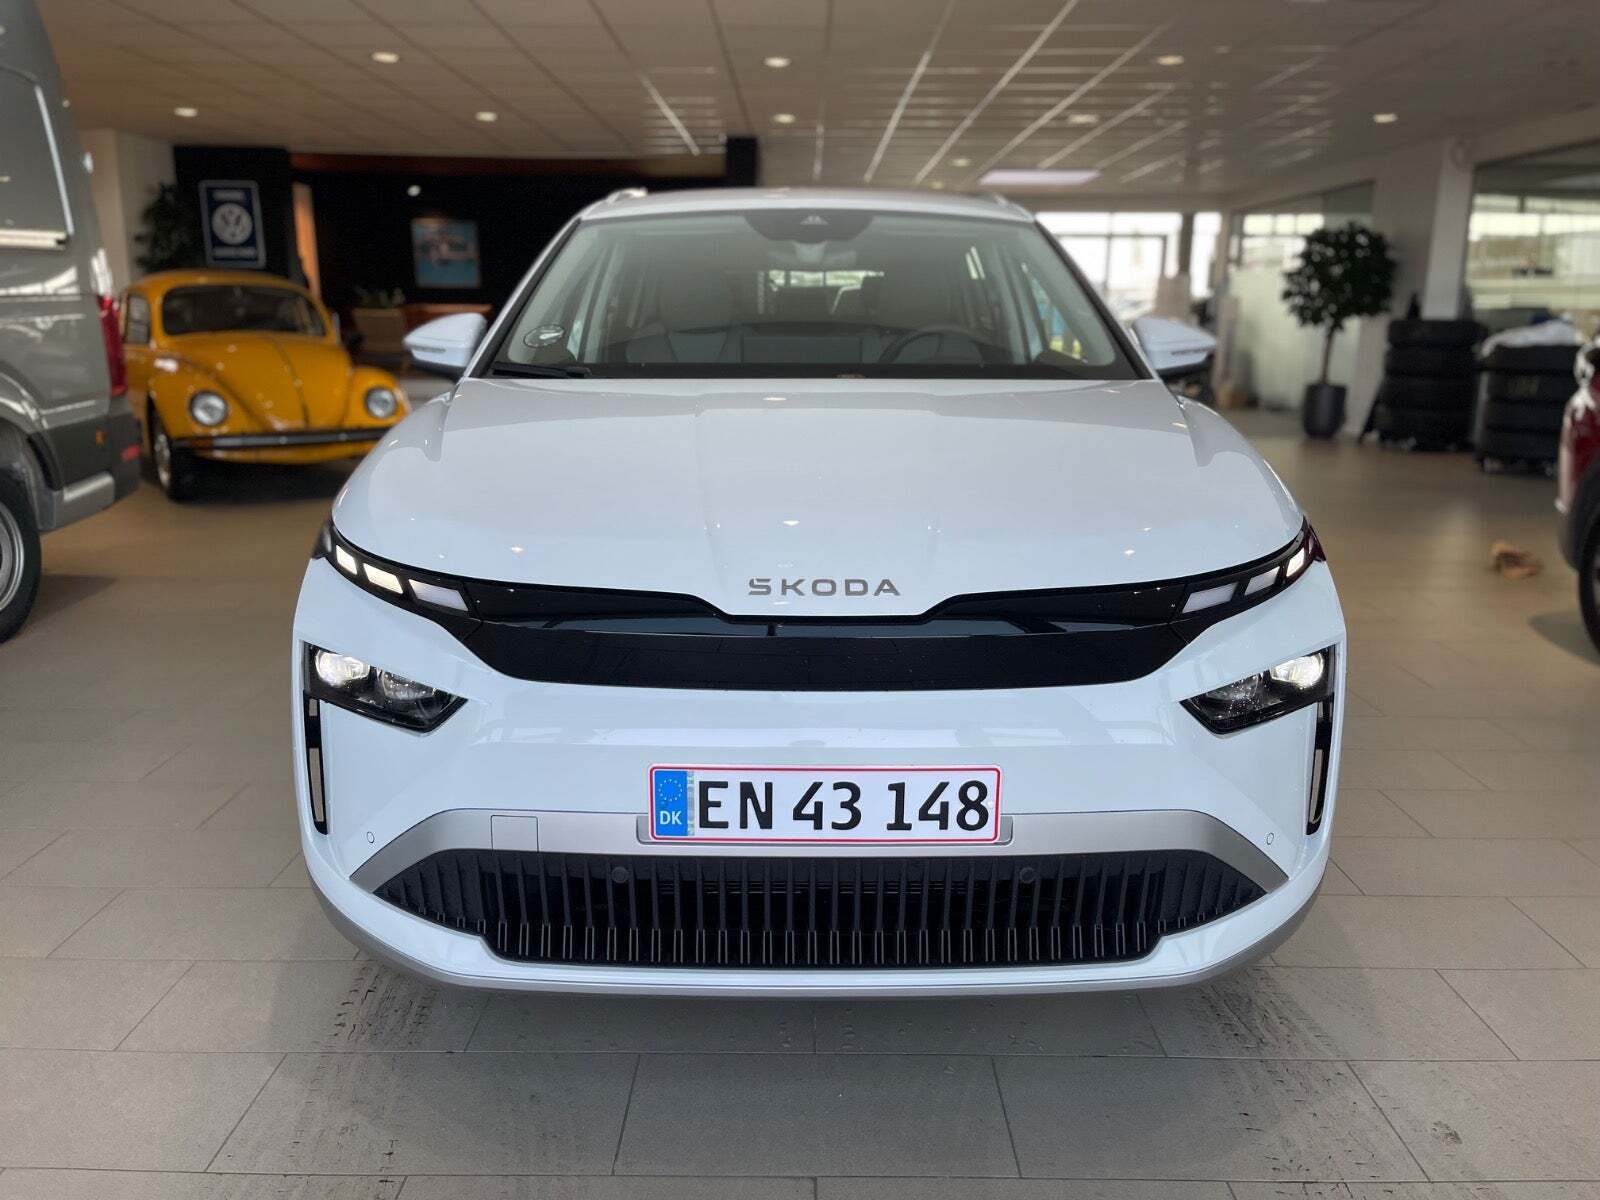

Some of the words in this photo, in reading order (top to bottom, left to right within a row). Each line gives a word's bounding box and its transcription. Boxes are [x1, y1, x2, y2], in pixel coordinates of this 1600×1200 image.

[748, 578, 901, 597] SKODA
[698, 780, 774, 830] EN
[792, 781, 862, 831] 43
[886, 779, 989, 832] 148
[659, 810, 682, 825] DK
